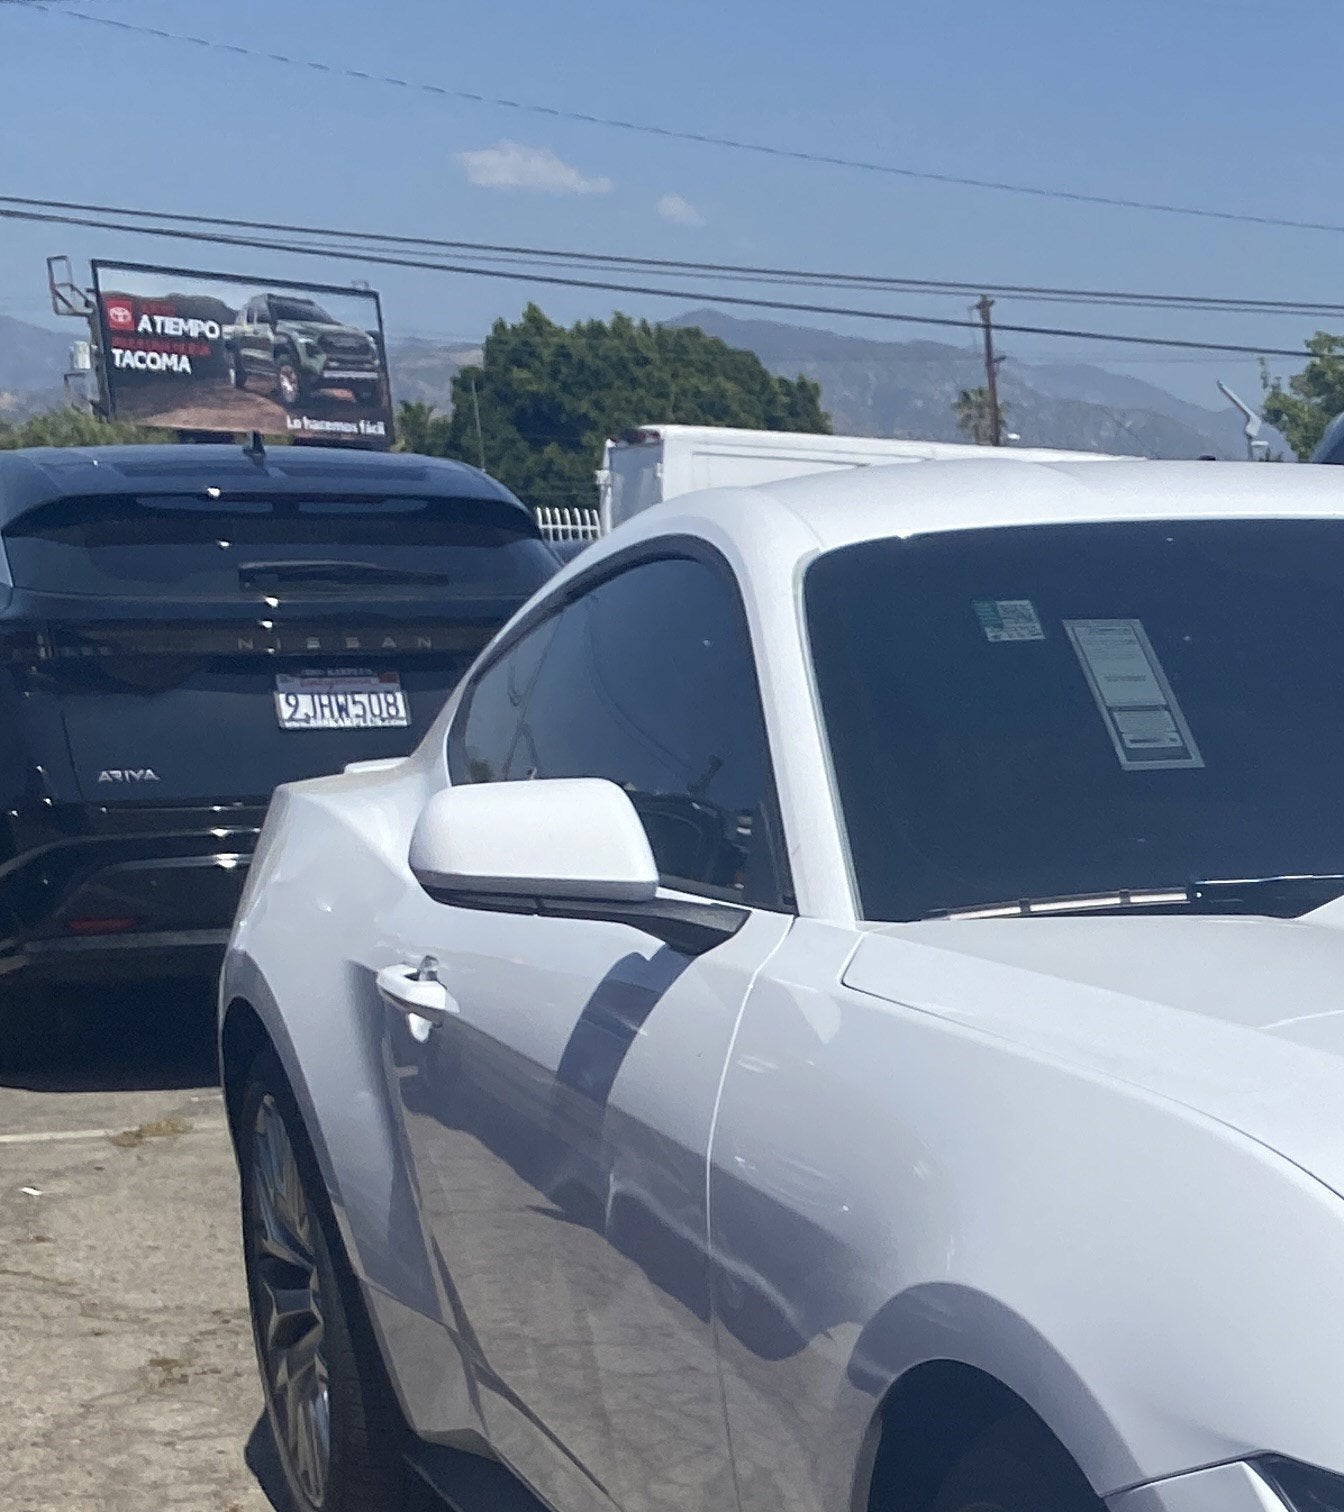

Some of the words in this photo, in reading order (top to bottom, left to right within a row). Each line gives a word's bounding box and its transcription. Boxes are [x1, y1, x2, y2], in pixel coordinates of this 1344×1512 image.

[111, 348, 192, 375] TACOMA
[237, 636, 432, 650] NISSAN
[98, 768, 160, 783] ARIVA
